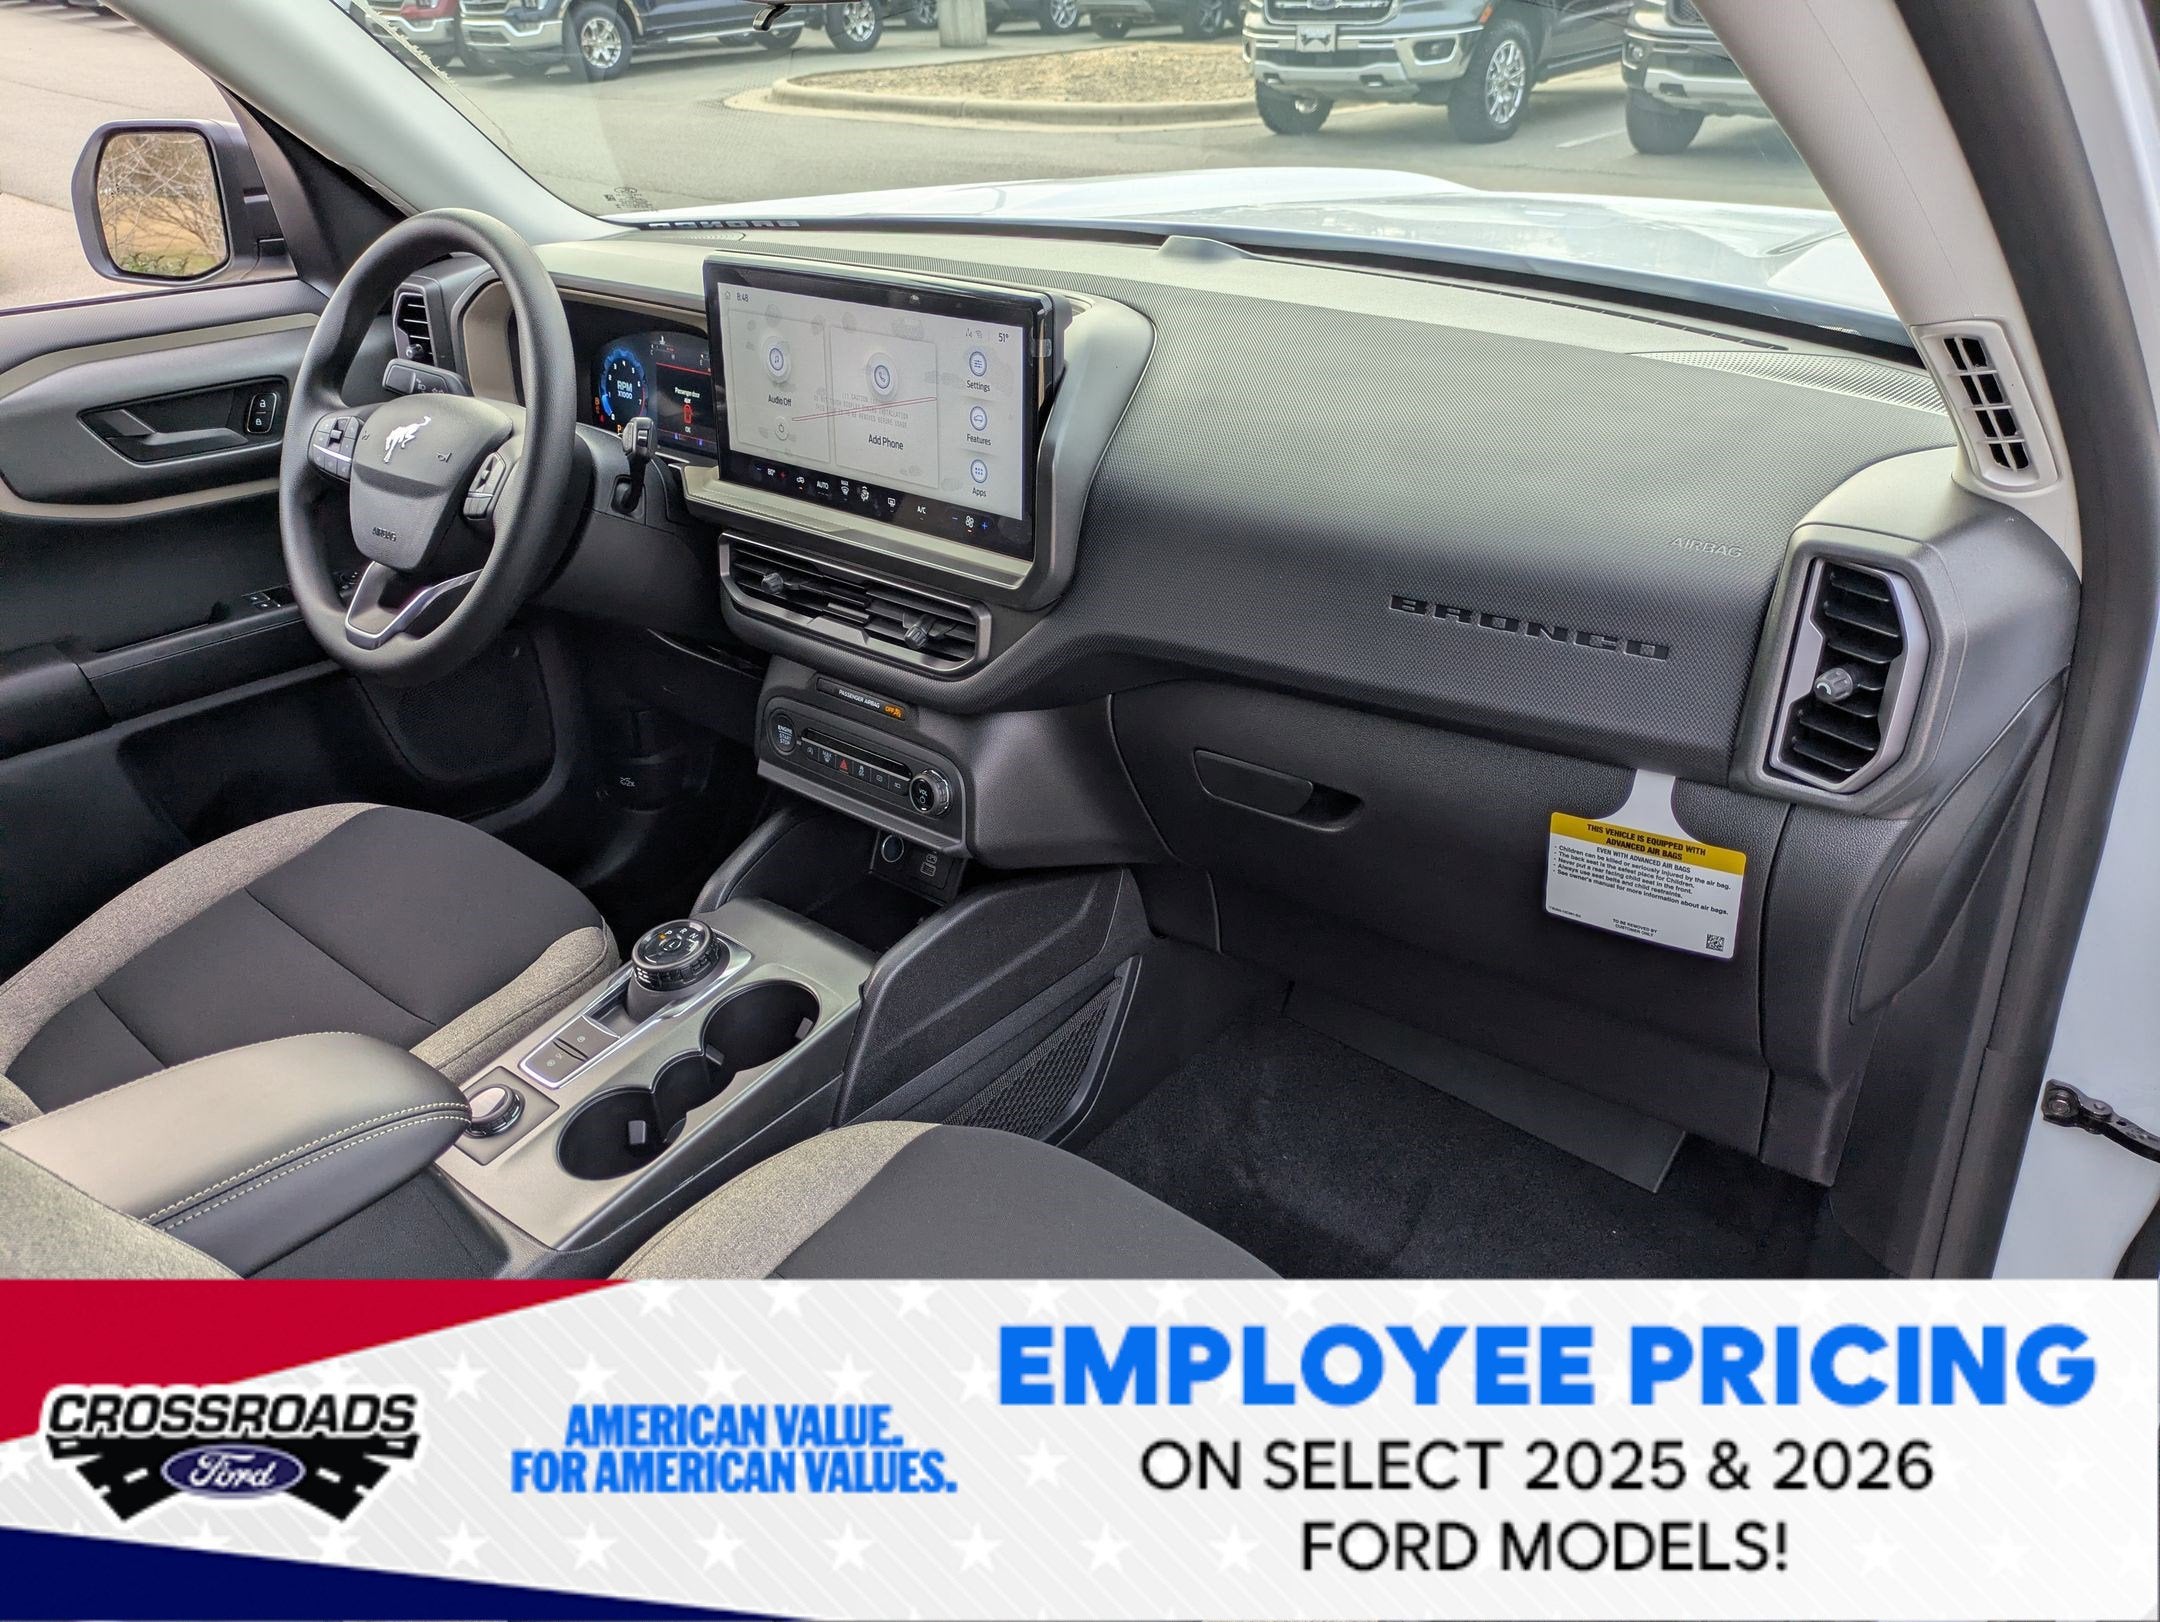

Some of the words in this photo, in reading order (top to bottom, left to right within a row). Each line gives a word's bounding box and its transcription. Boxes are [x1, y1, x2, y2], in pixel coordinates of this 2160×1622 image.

[616, 380, 633, 393] RPM
[966, 380, 990, 393] Settings
[768, 394, 783, 405] Audio
[783, 397, 792, 406] Off
[868, 434, 882, 446] Add
[882, 437, 904, 451] Phone
[966, 433, 992, 446] Features
[816, 481, 829, 490] AUTO
[972, 487, 987, 497] Apps
[371, 526, 397, 542] AIRBAG
[1669, 536, 1743, 559] AIRBAG
[1388, 594, 1670, 661] BRONCO
[838, 689, 864, 702] PASSENGER
[863, 699, 880, 709] AIRBAG
[1587, 824, 1604, 833] THIS
[1605, 828, 1635, 841] VEHICLE
[1637, 834, 1645, 842] IS
[1646, 837, 1683, 851] EQUIPPED
[1685, 845, 1706, 856] WITH
[1606, 837, 1645, 852] ADVANCED
[1647, 846, 1660, 856] AIR
[1662, 850, 1682, 860] BAGS
[1558, 851, 1570, 860] The
[1570, 854, 1585, 862] back
[1586, 858, 1599, 866] seat
[1606, 862, 1616, 870] the
[1617, 865, 1637, 874] safest
[1637, 869, 1654, 879] place
[1665, 877, 1695, 888] Children.
[1559, 845, 1583, 856] Children
[1597, 853, 1604, 861] be
[1606, 856, 1622, 865] killed
[1631, 862, 1660, 875] seriously
[1661, 869, 1684, 880] injured
[1685, 875, 1693, 883] by
[1694, 877, 1705, 885] the
[1716, 882, 1731, 890] bag.
[1596, 847, 1612, 856] EVEN
[1612, 850, 1628, 859] WITH
[1630, 854, 1661, 867] ADVANCED
[1674, 865, 1691, 873] BAGS
[1557, 864, 1578, 873] Always
[1592, 872, 1604, 880] seat
[1605, 875, 1620, 883] belts
[1621, 879, 1633, 887] and
[1634, 882, 1650, 891] child
[1651, 886, 1683, 899] restraints.
[1558, 857, 1575, 866] Never
[1576, 861, 1586, 869] put
[1605, 869, 1624, 879] facing
[1625, 873, 1641, 882] child
[1641, 878, 1655, 886] seat
[1664, 882, 1674, 890] the
[1675, 884, 1693, 894] front.
[1569, 873, 1592, 883] owner's
[1593, 879, 1615, 888] manual
[1626, 887, 1642, 895] more
[1643, 891, 1680, 904] information
[1680, 900, 1700, 909] about
[1710, 906, 1729, 915] bags.
